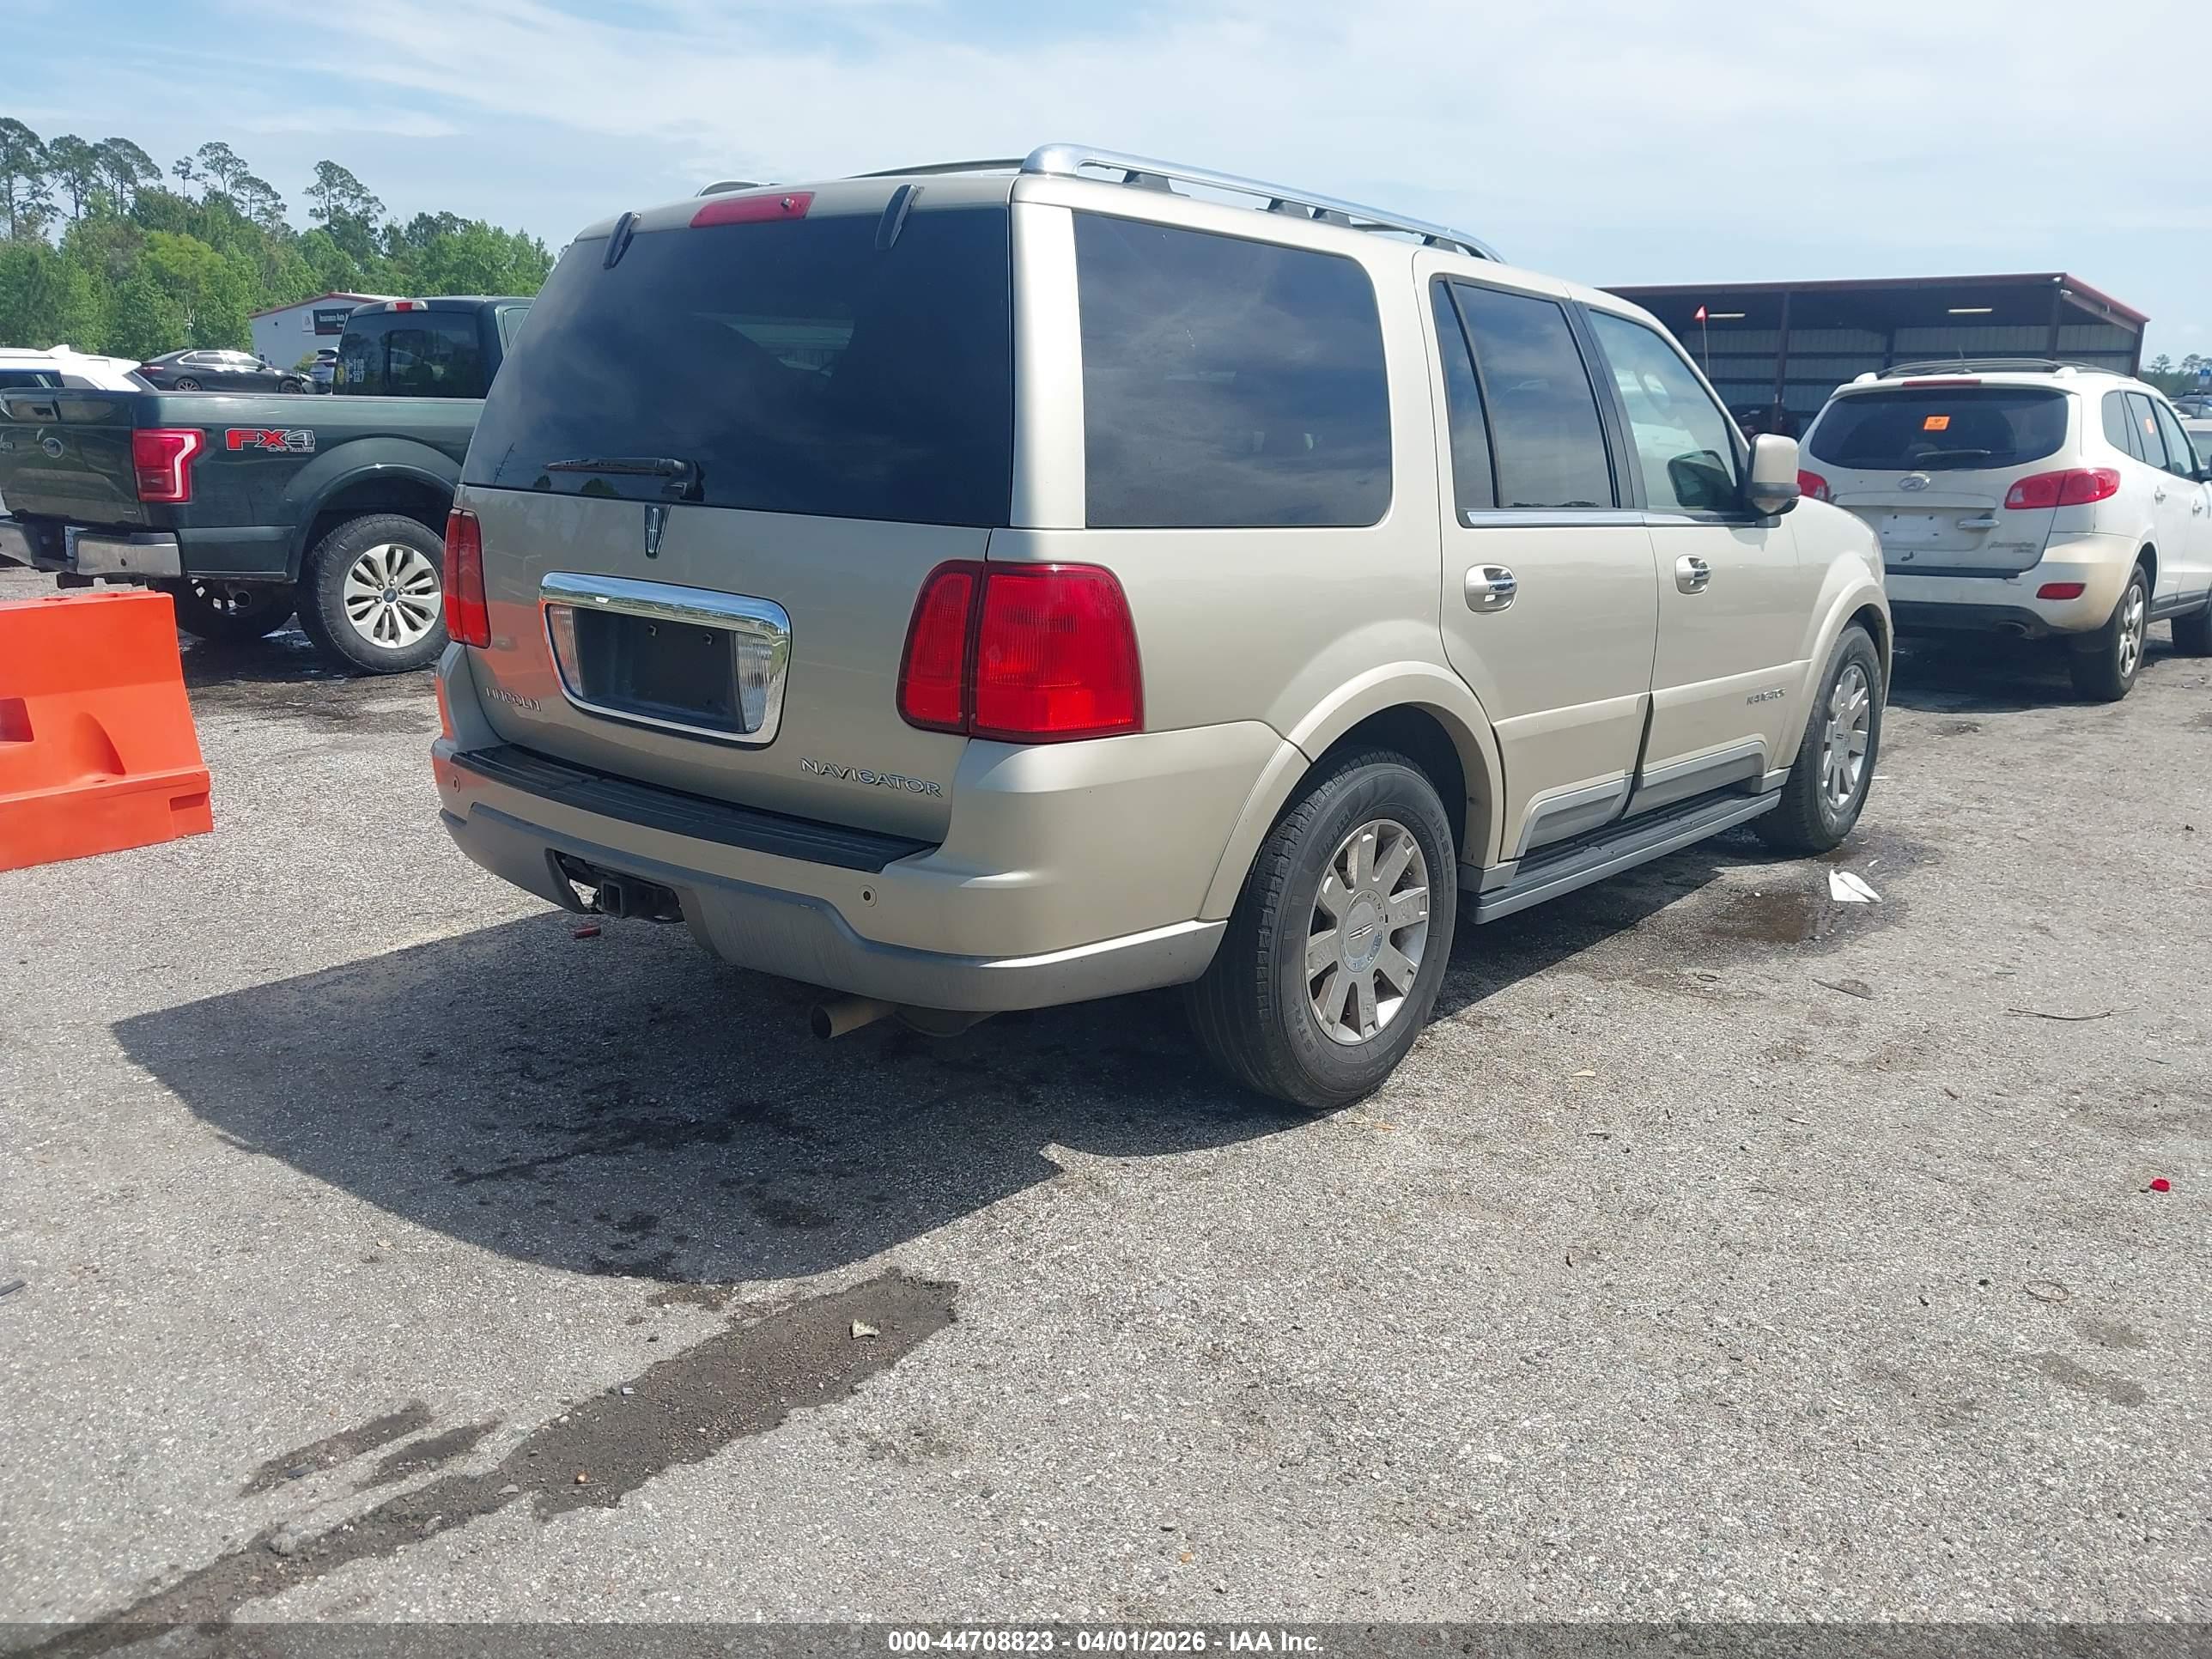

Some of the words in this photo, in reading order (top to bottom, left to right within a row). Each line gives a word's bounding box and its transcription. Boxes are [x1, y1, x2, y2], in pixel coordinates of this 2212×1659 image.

[225, 428, 315, 450] FX4
[486, 687, 541, 712] LINCOLN
[799, 758, 942, 798] NAVIGATOR
